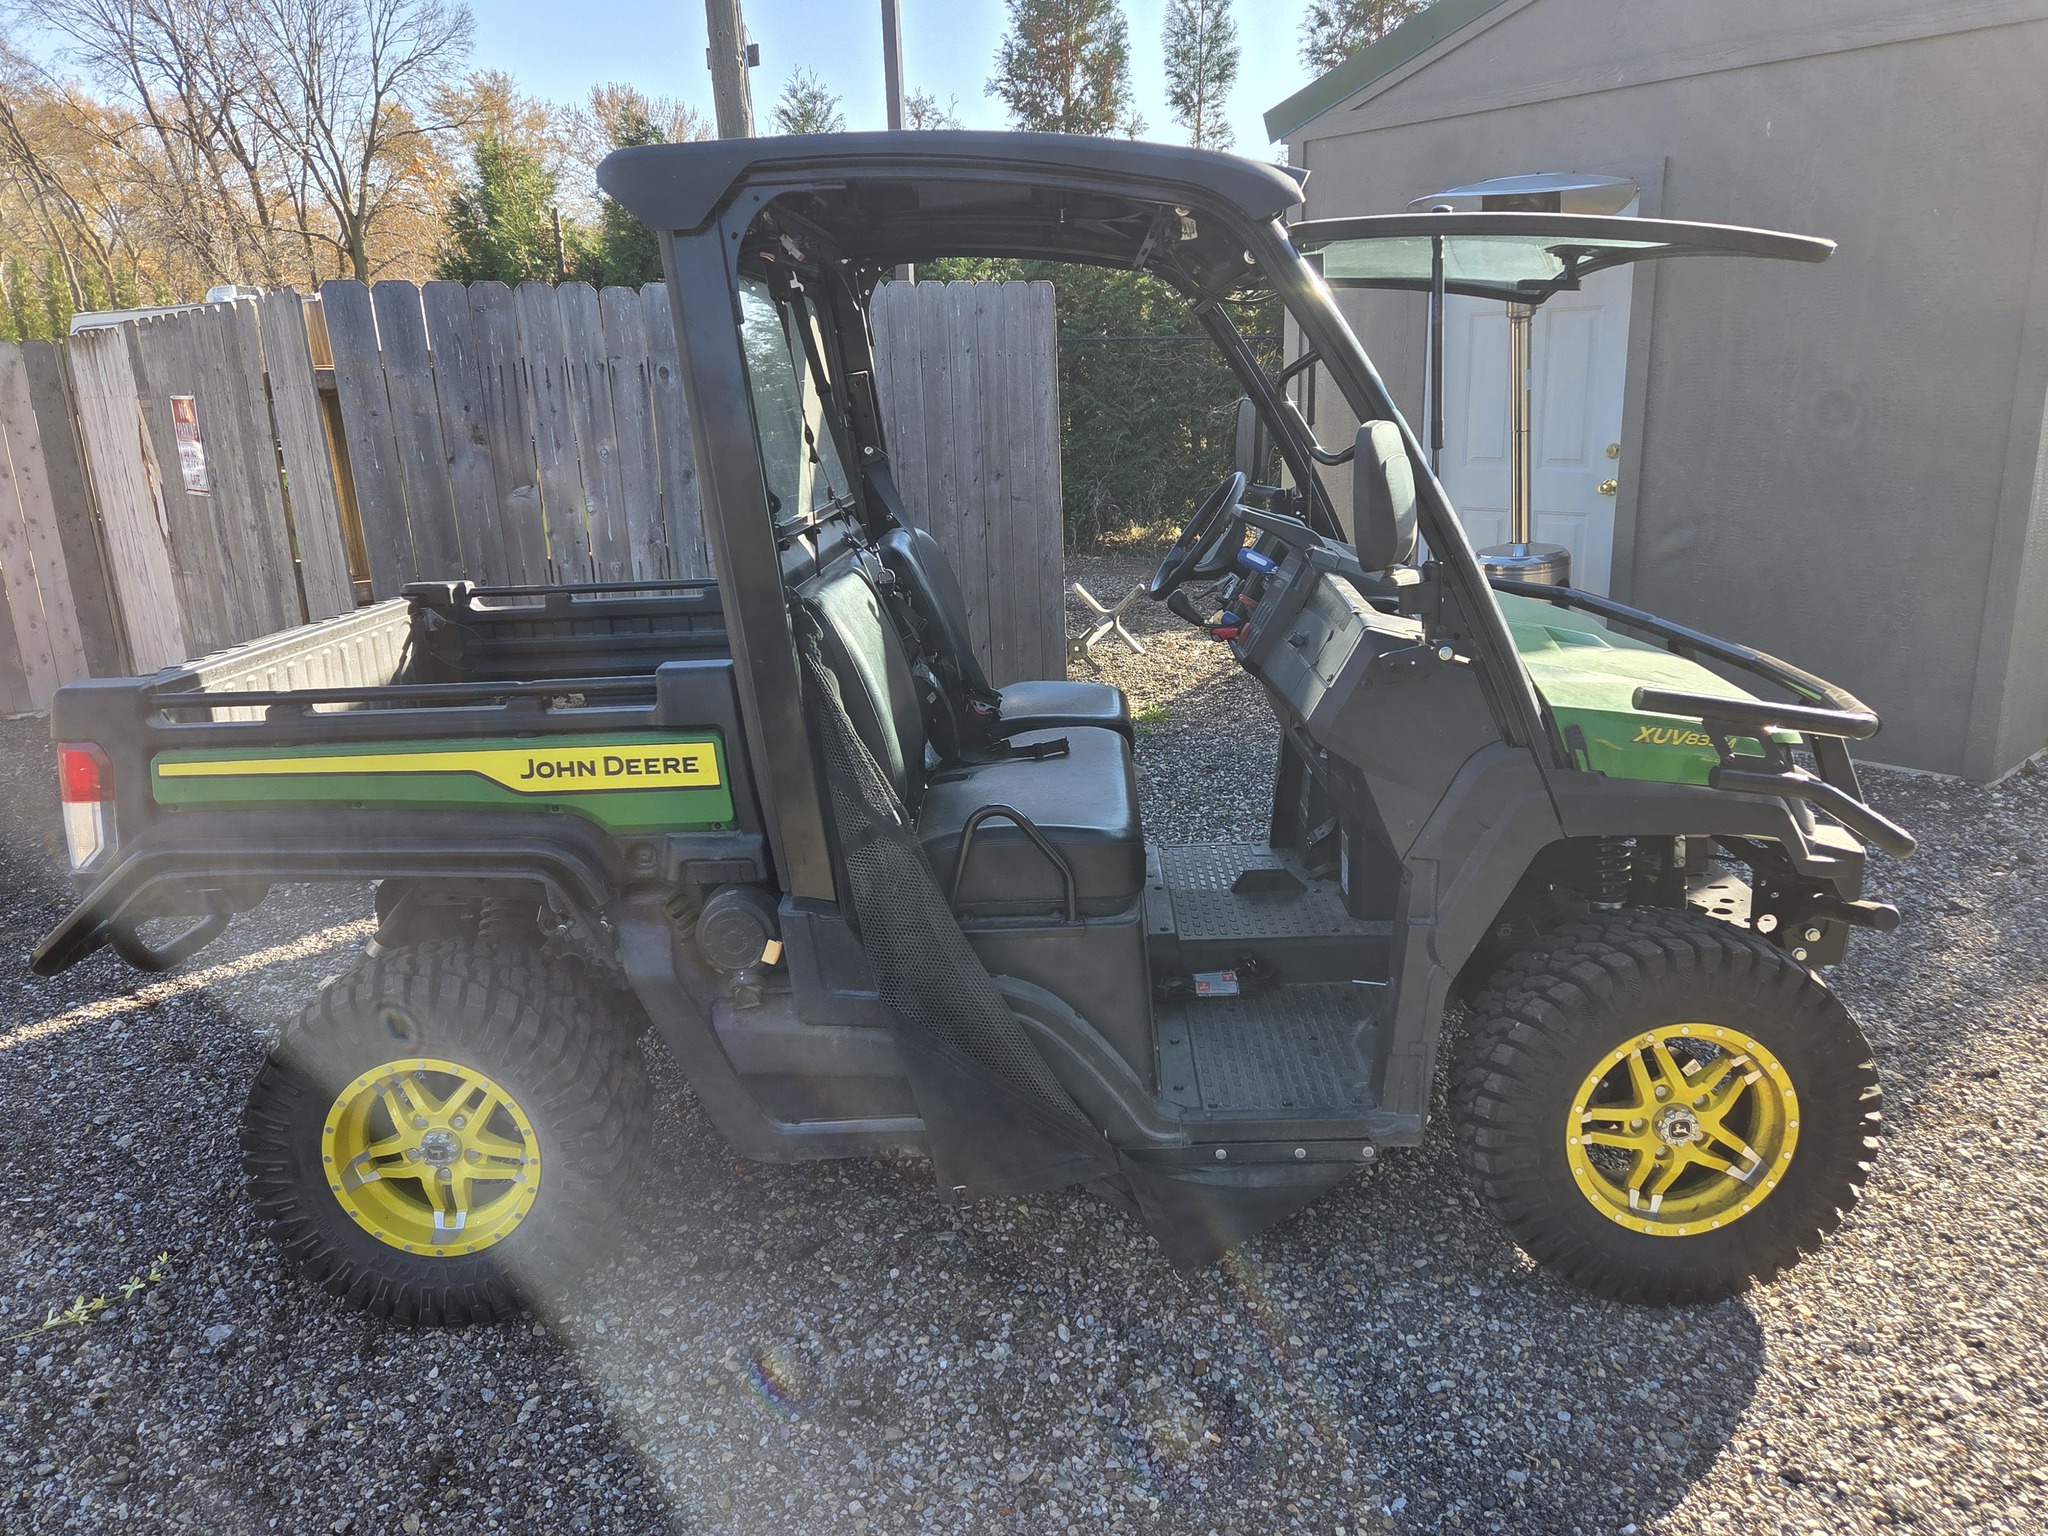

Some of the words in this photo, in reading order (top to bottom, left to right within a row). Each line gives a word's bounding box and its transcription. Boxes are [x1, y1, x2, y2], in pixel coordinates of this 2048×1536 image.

[178, 402, 190, 420] NO
[177, 422, 199, 439] PARKING
[520, 758, 596, 779] JOHN
[603, 756, 699, 776] DEERE
